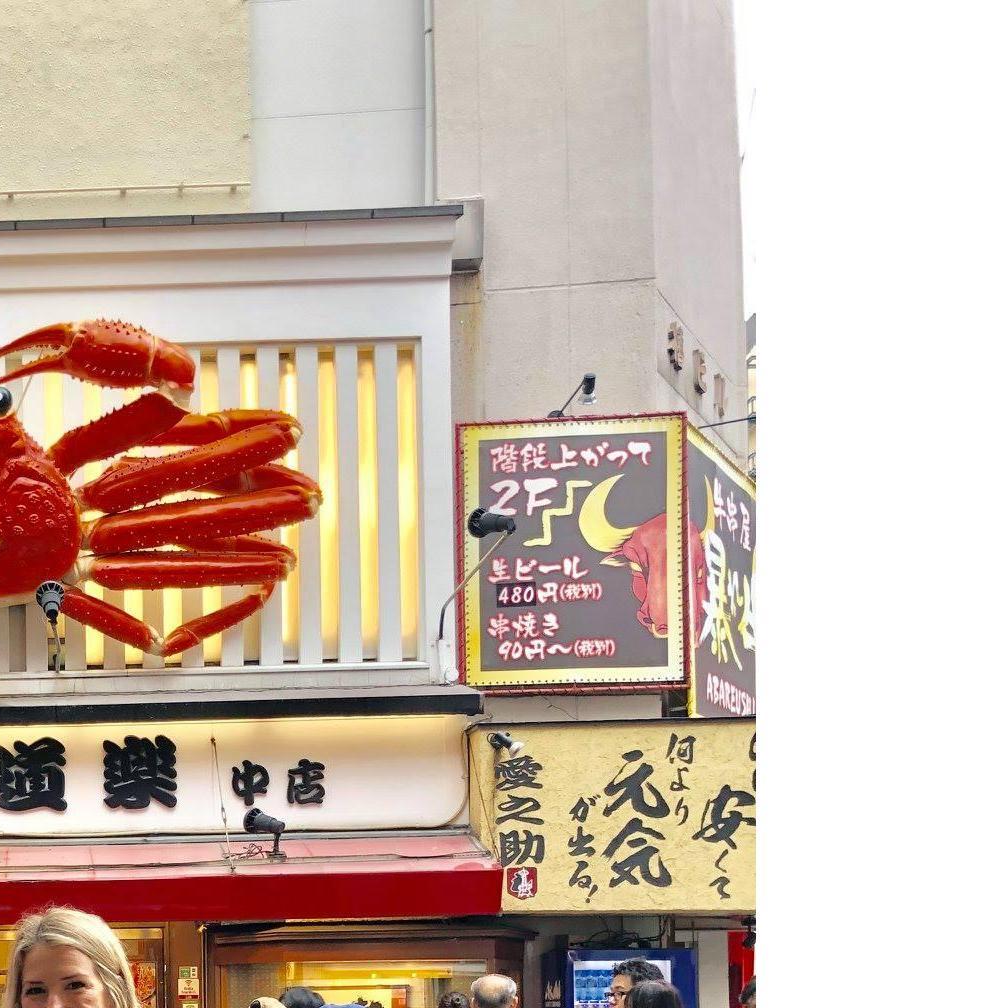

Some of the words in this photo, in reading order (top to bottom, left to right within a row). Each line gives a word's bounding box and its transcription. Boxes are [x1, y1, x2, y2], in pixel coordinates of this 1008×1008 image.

[490, 441, 652, 473] 階段上がって
[489, 477, 559, 517] 2F
[488, 556, 589, 583] 生ビール
[488, 611, 560, 639] 串焼き
[231, 759, 327, 808] 中店
[665, 732, 697, 826] 何より
[494, 755, 546, 868] 愛之助
[600, 749, 673, 889] 元気
[692, 784, 756, 900] 安くて
